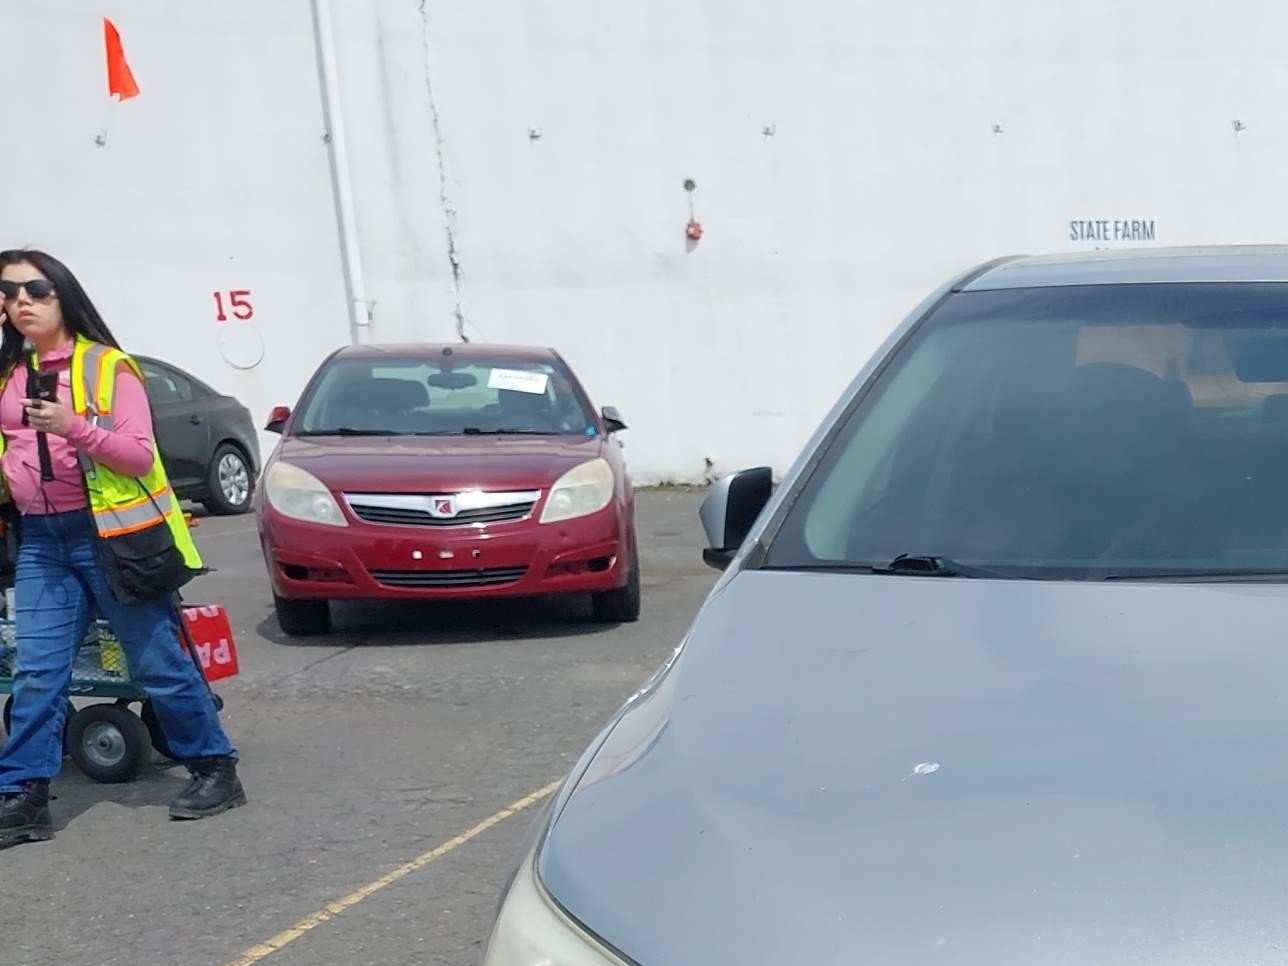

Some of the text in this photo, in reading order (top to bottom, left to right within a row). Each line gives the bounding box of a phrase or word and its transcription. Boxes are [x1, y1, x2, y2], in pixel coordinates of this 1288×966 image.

[1070, 220, 1156, 241] STATE FARM
[213, 289, 254, 321] 15
